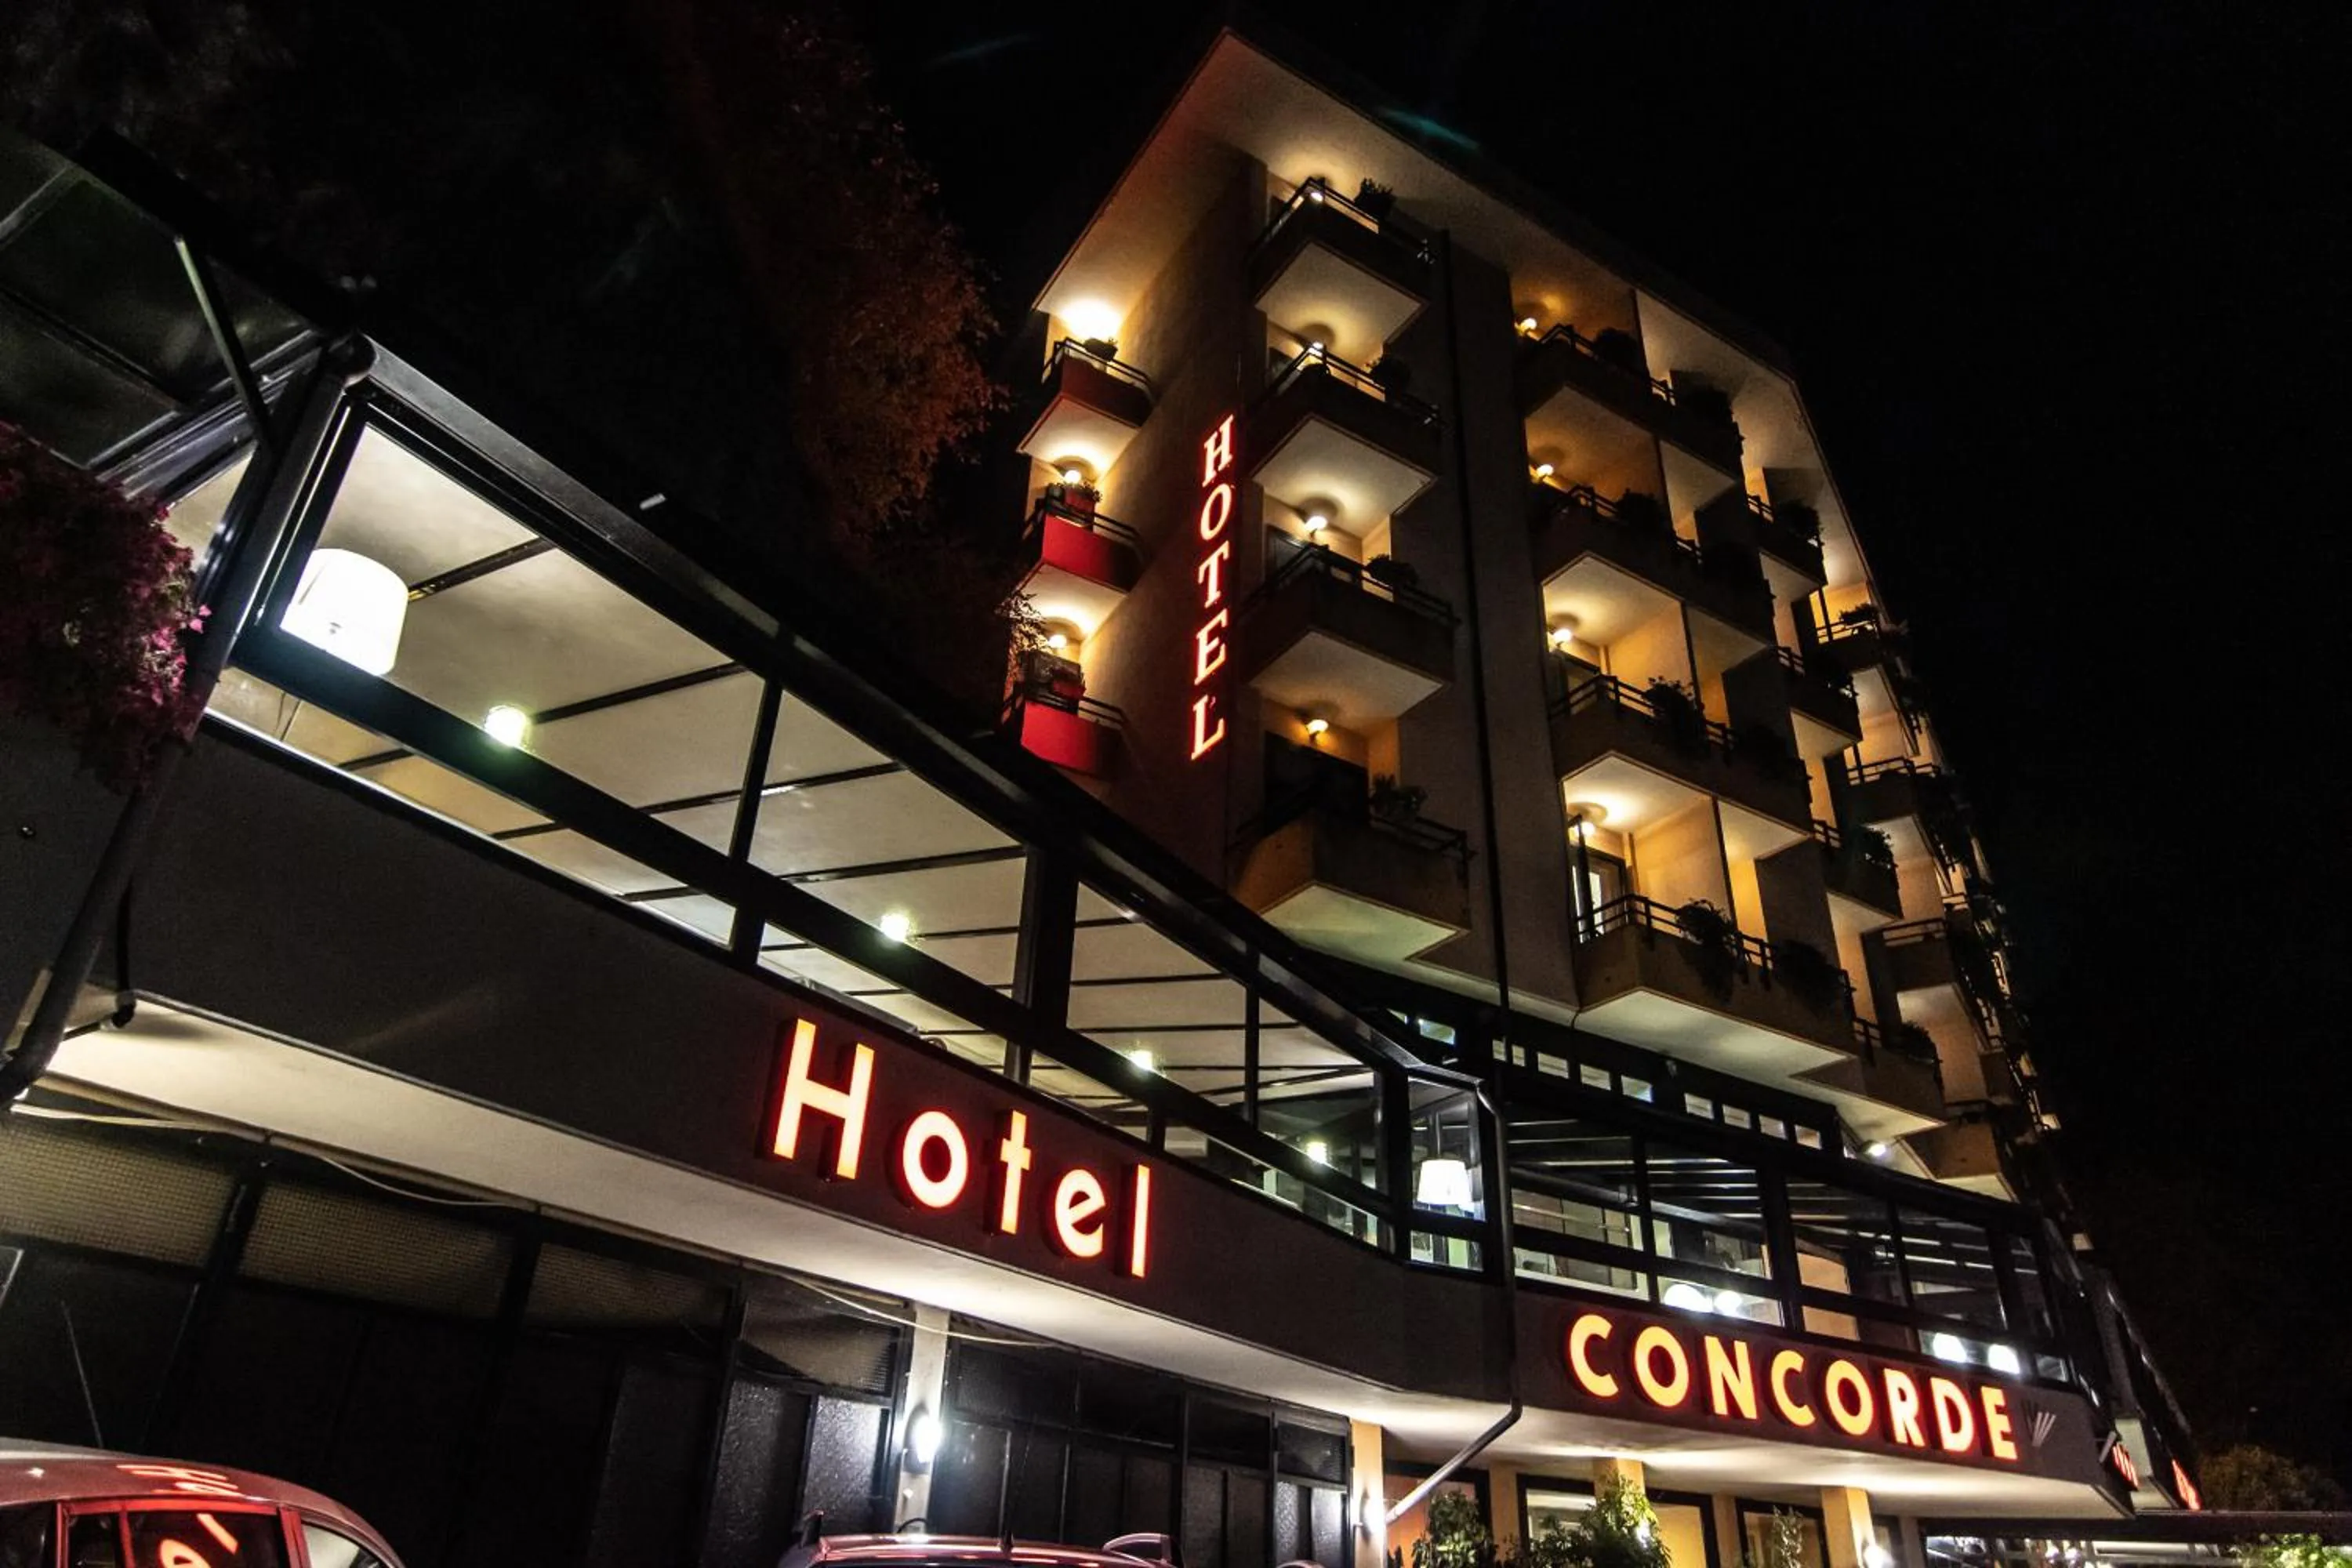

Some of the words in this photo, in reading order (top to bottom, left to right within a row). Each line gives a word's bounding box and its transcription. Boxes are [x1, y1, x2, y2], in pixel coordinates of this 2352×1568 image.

[1190, 414, 1234, 760] HOTEL
[772, 1017, 1152, 1279] Hotel
[1567, 1312, 2019, 1461] CONCORDE
